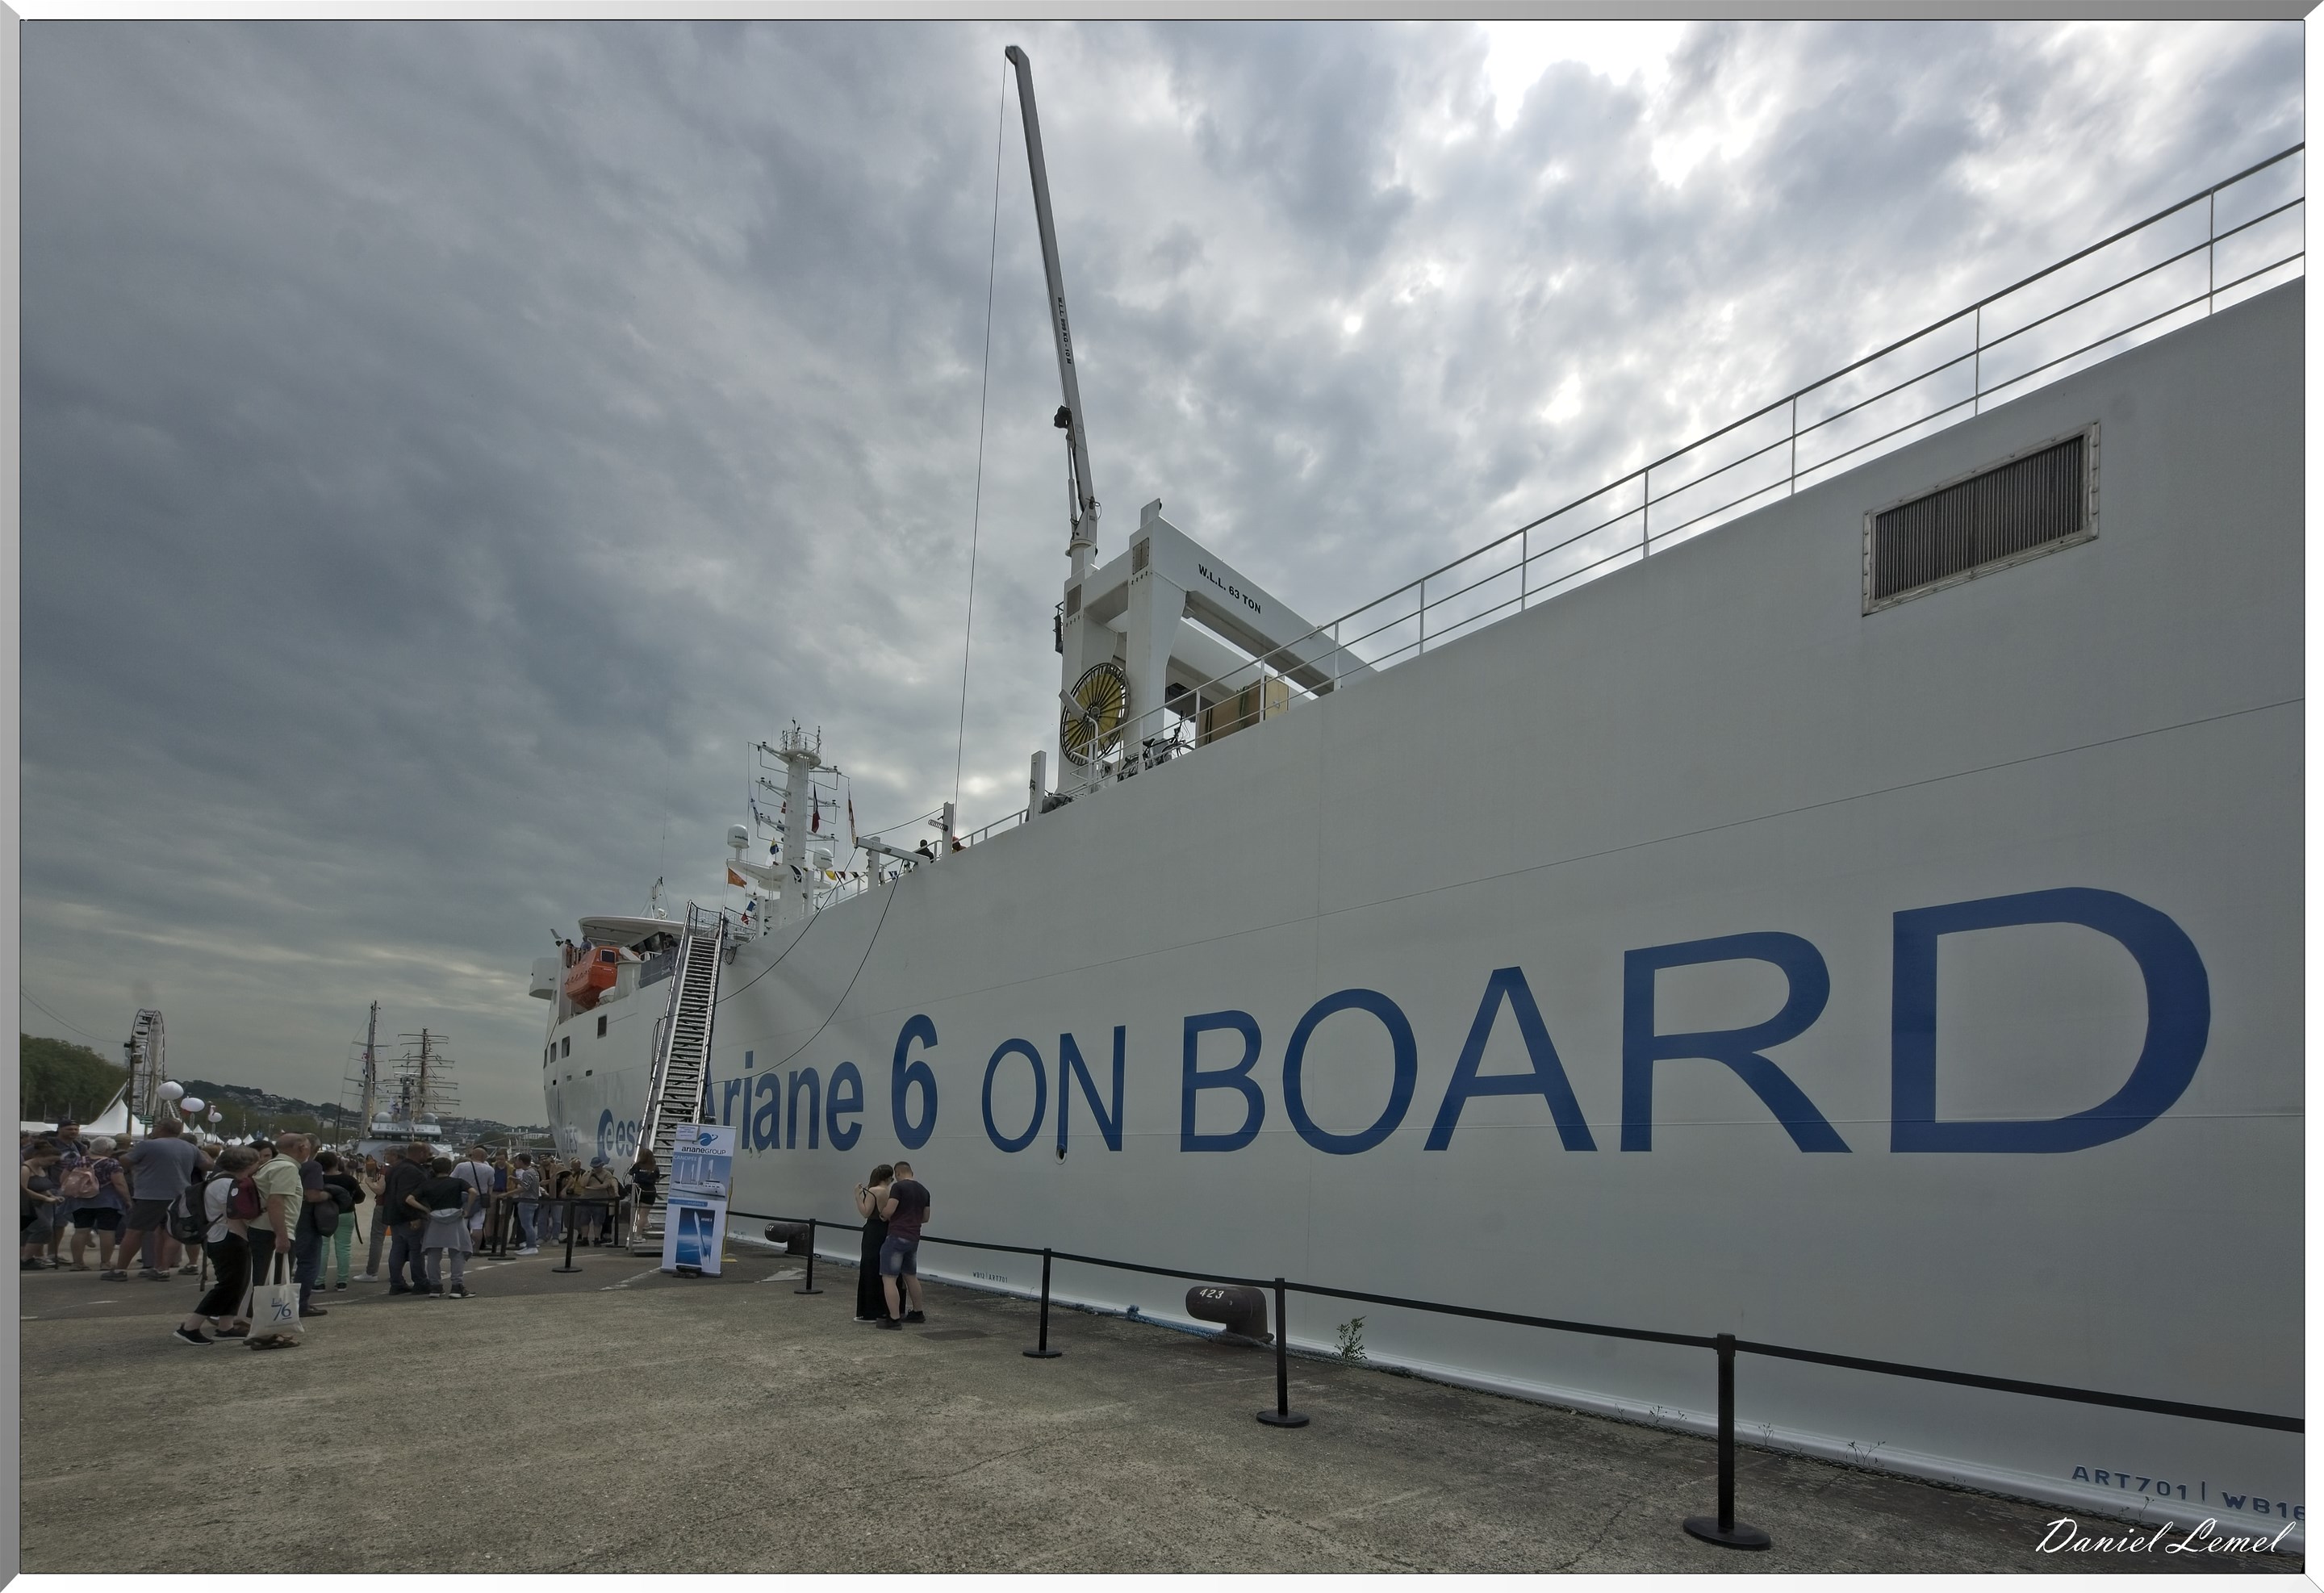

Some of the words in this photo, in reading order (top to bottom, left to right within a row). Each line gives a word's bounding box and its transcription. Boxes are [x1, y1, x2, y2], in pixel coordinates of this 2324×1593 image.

[1198, 563, 1227, 591] W.L.L.
[1228, 585, 1240, 600] 63
[1242, 594, 1261, 614] TON
[891, 1014, 938, 1151] 6
[981, 1025, 1126, 1153] ON
[1179, 887, 2212, 1156] BOARD
[271, 1302, 291, 1321] 76
[1199, 1288, 1224, 1299] 423
[2071, 1465, 2188, 1501] ART701
